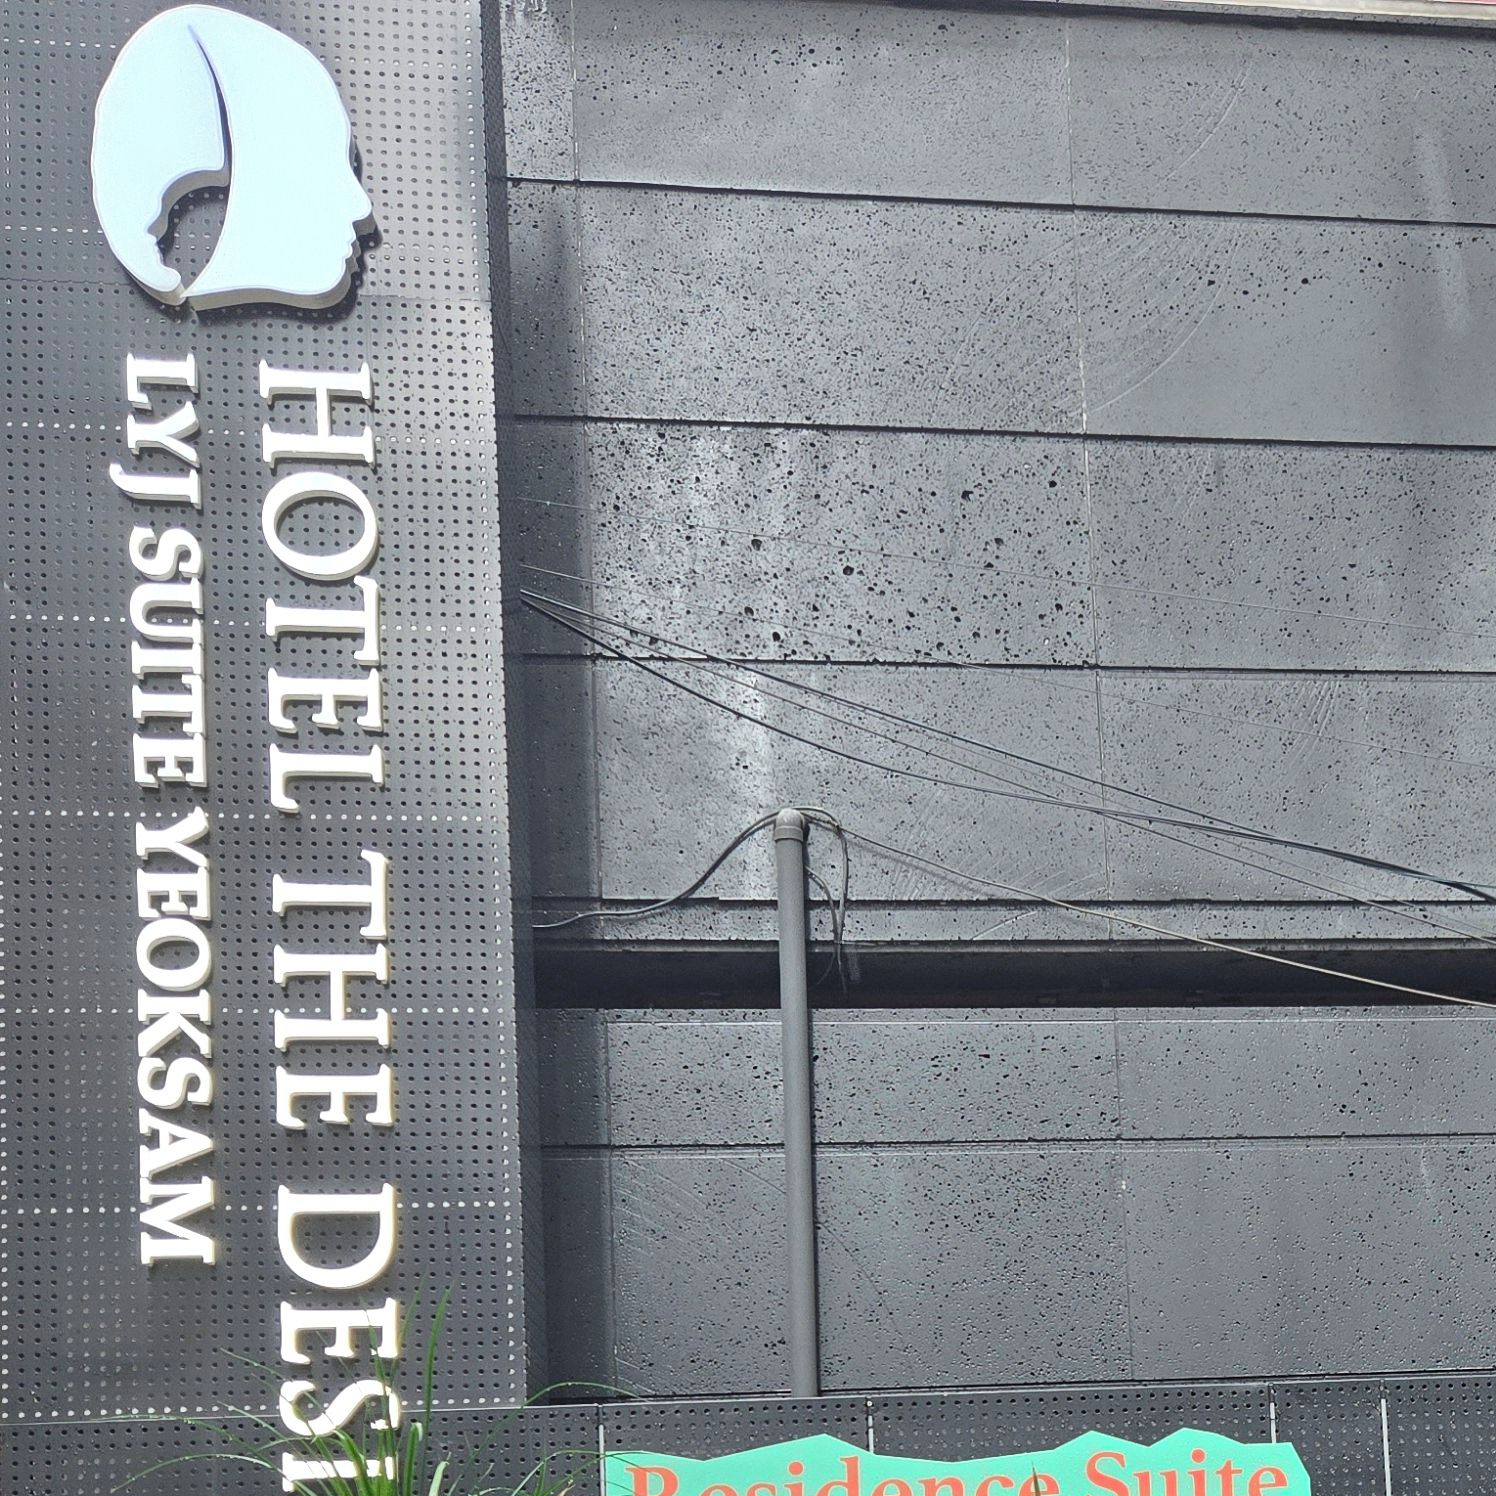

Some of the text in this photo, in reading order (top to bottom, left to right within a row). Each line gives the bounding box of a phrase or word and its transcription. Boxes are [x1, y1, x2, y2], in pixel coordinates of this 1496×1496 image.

[110, 352, 217, 1267] LYJ SUITE YEOKSAM
[258, 359, 384, 815] HOTEL
[271, 847, 394, 1132] THE
